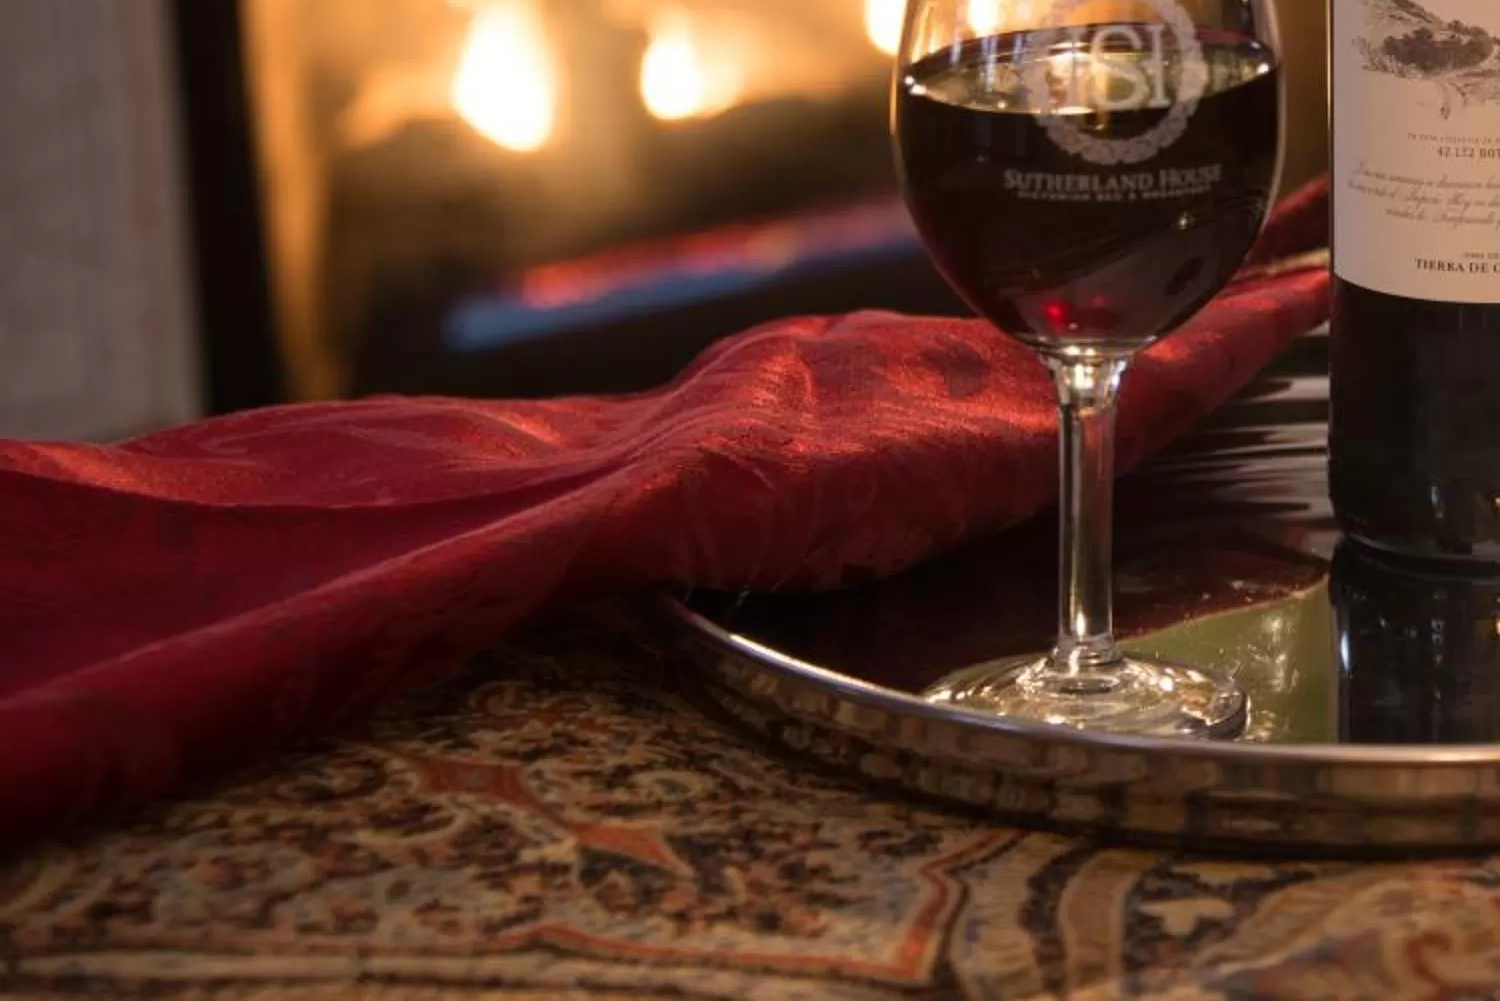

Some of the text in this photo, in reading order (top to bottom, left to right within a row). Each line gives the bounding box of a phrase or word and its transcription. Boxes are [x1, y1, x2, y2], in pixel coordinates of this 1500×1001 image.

[1003, 167, 1154, 193] SUTHERLAND
[1158, 163, 1223, 187] HOUSE
[1414, 257, 1465, 272] TIERRA
[1468, 262, 1489, 274] DE
